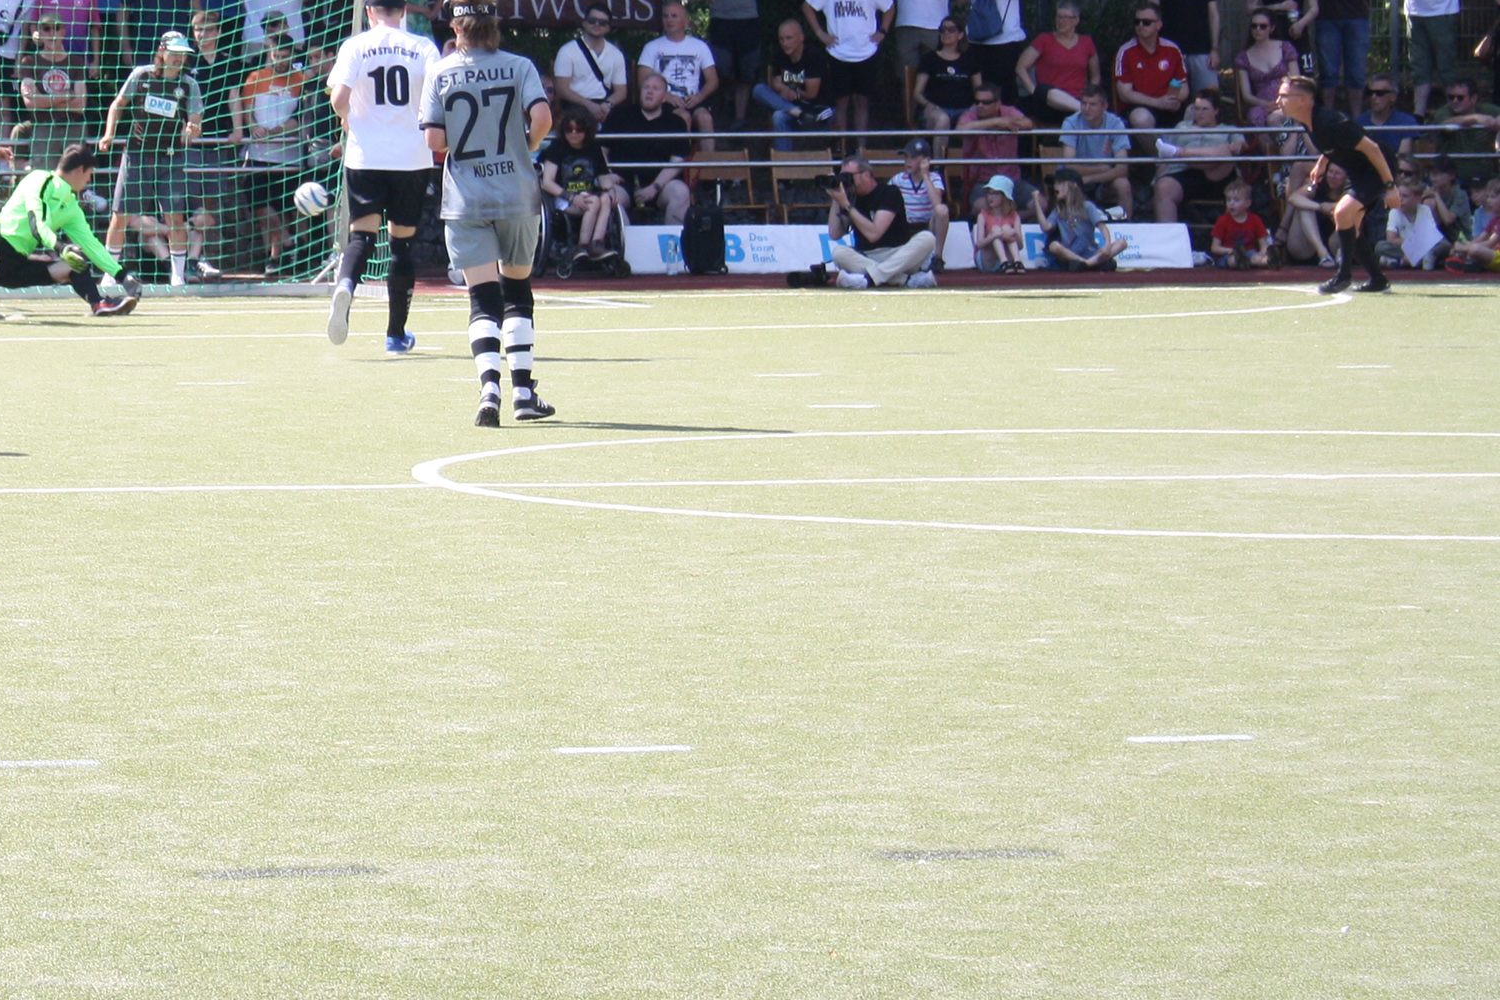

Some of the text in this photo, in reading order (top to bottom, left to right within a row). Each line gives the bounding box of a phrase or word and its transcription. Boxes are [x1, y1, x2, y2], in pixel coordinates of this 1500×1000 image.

[465, 67, 514, 84] PAULI
[367, 64, 410, 106] 10
[445, 86, 516, 162] 27
[473, 160, 515, 178] KÜSTER
[749, 233, 768, 242] Das
[1114, 231, 1134, 241] Das
[657, 233, 745, 263] DB
[752, 254, 777, 263] Bank
